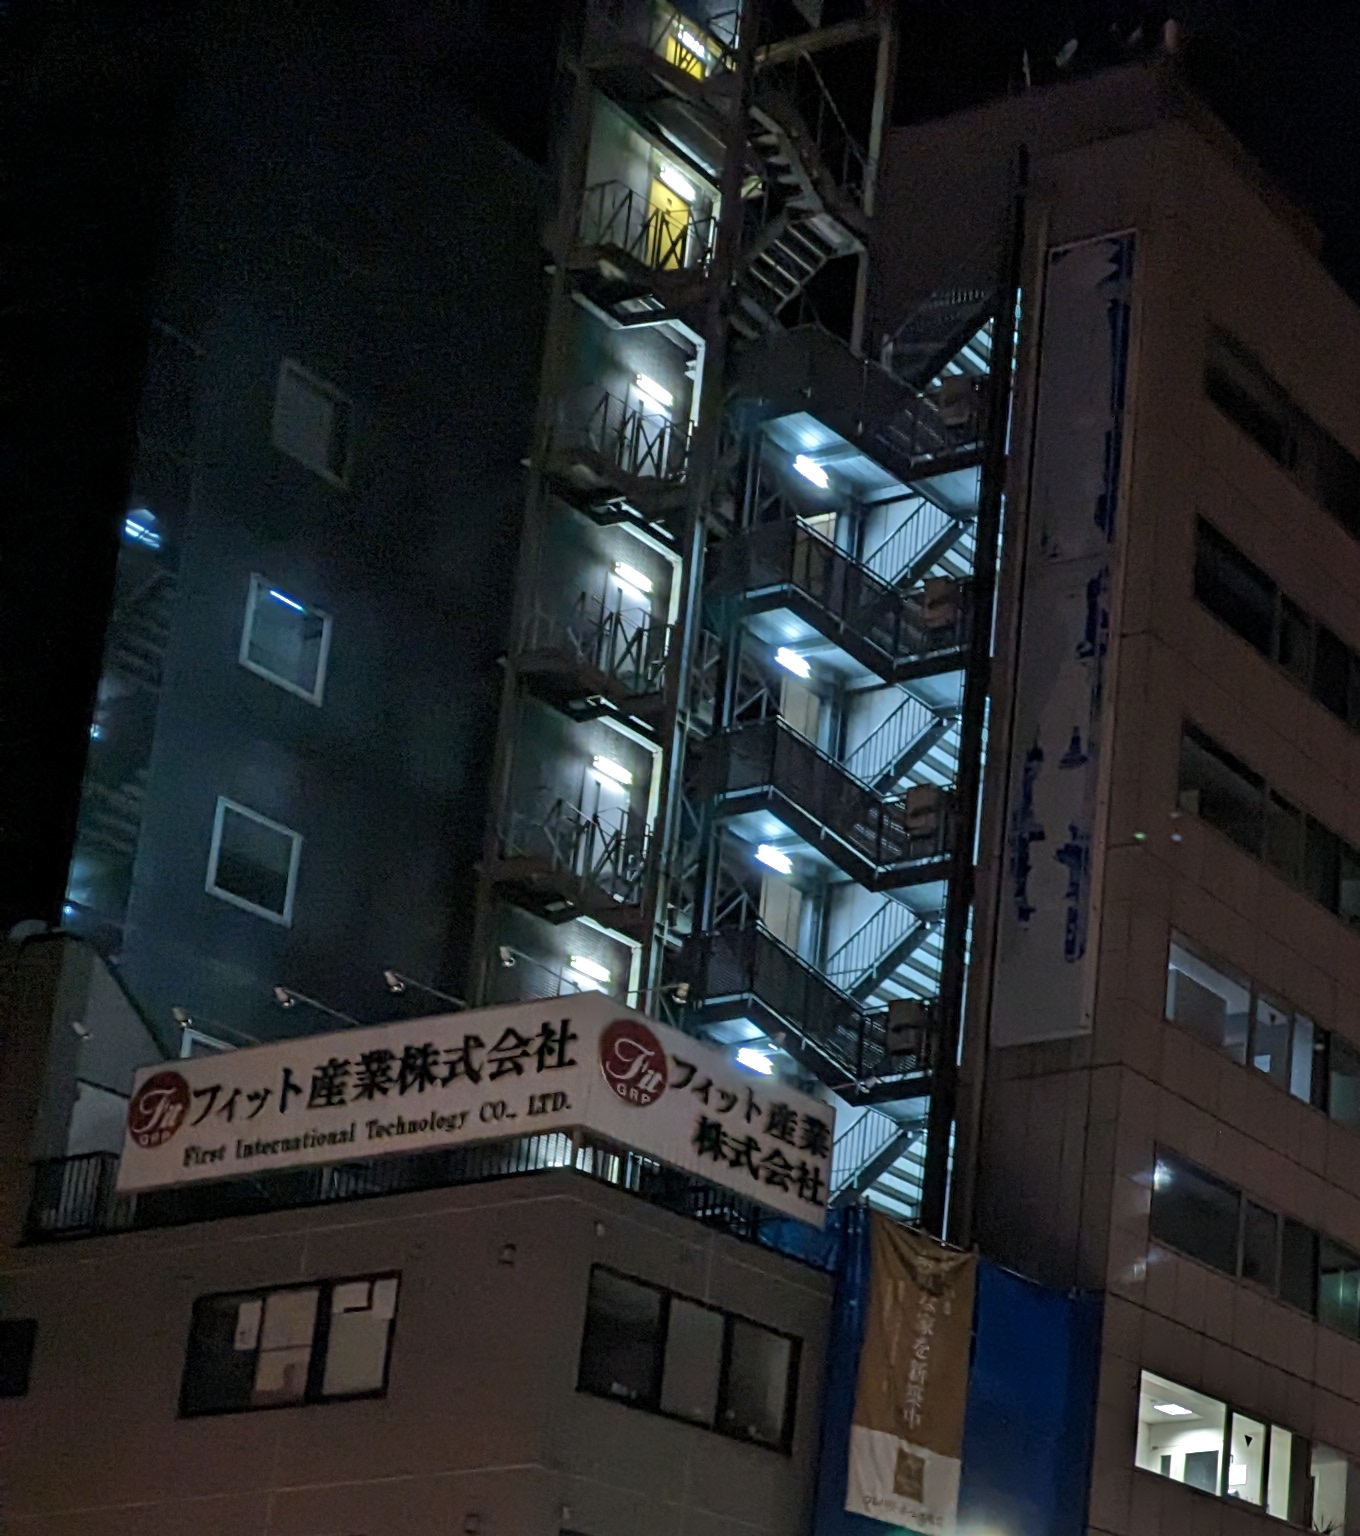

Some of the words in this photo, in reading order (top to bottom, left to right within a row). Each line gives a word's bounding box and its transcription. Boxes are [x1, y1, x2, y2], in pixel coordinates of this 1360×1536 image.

[190, 1018, 578, 1126] フィット産業株式会社
[616, 1083, 651, 1104] GRP
[670, 1055, 830, 1159] フィット産業
[183, 1143, 227, 1168] First
[235, 1122, 355, 1159] International
[365, 1110, 471, 1140] Technology
[526, 1091, 573, 1116] LTD.
[691, 1115, 824, 1206] 株式会社
